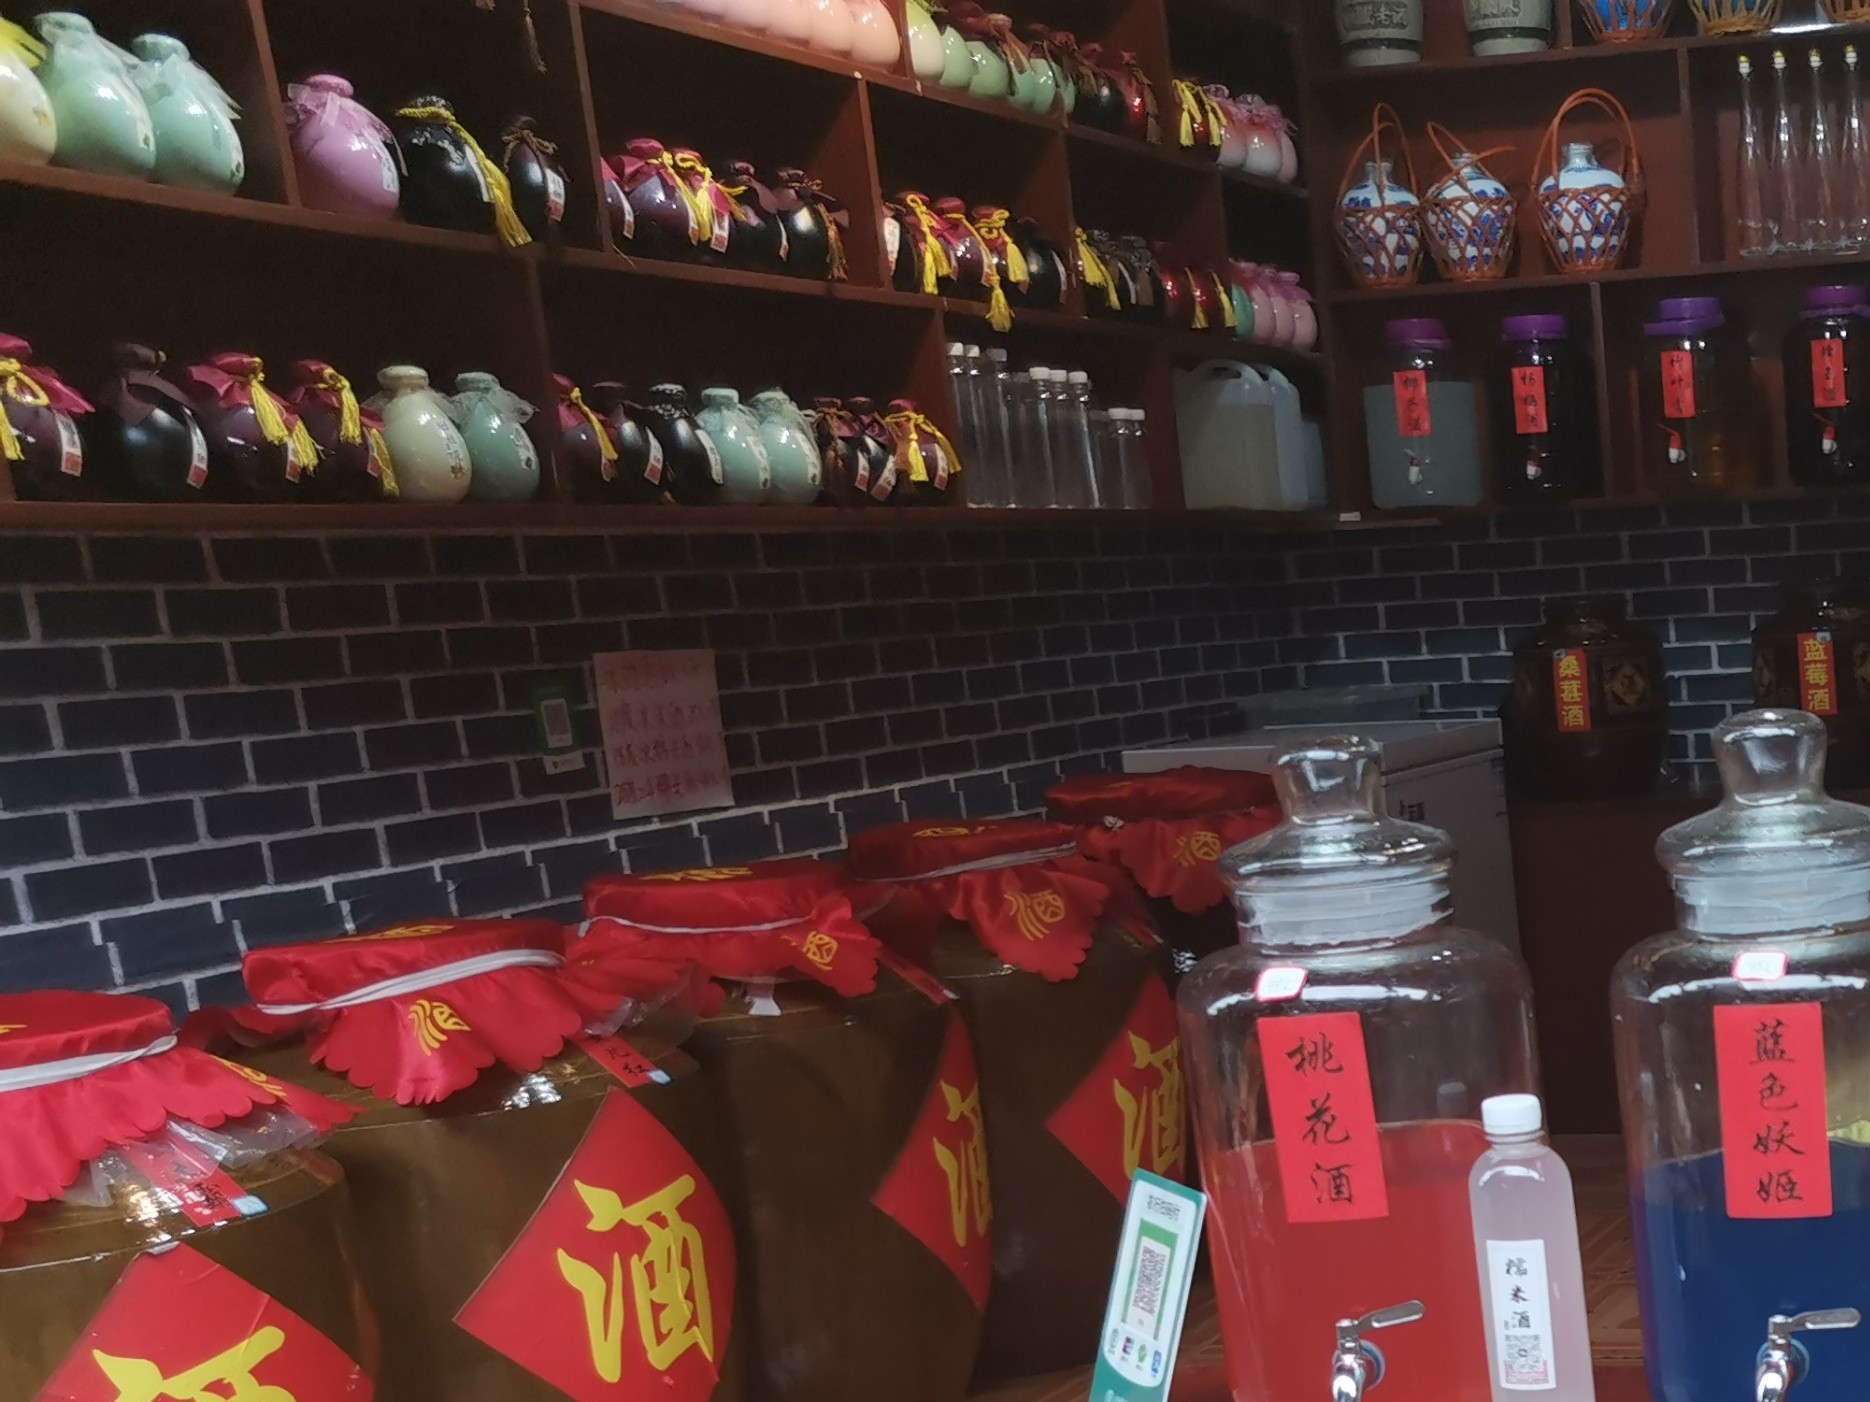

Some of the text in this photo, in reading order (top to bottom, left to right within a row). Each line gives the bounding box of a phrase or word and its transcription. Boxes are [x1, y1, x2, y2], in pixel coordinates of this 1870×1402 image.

[1802, 639, 1831, 712] 蓝莓酒
[1285, 1033, 1353, 1207] 桃花酒
[558, 1174, 713, 1384] 酒
